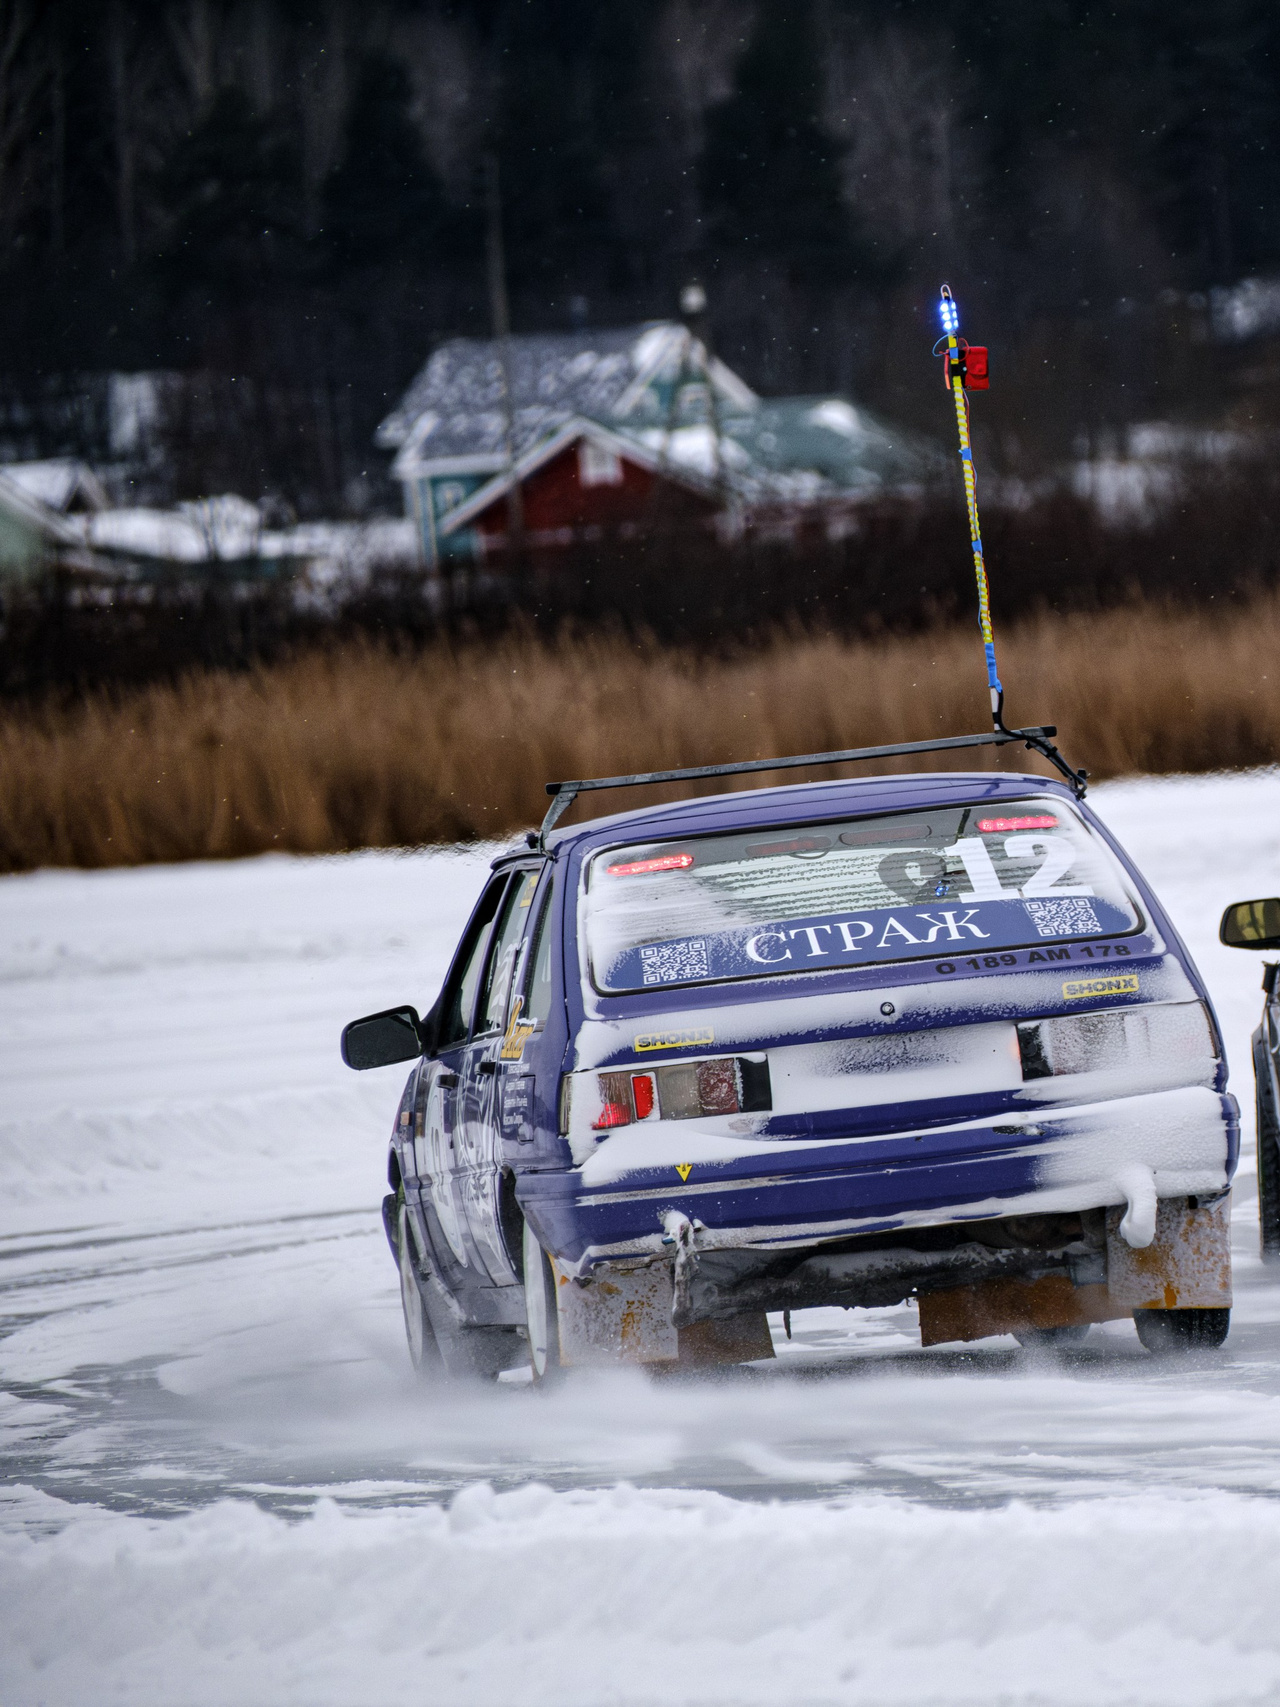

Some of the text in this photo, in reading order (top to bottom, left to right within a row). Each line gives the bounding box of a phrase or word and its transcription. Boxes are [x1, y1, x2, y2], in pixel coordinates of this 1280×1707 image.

[944, 834, 1095, 904] 12
[746, 909, 991, 964] СТРАЖ
[966, 953, 1018, 971] 189
[1028, 948, 1072, 963] АМ
[1080, 945, 1132, 958] 178
[1066, 979, 1137, 996] SHONX
